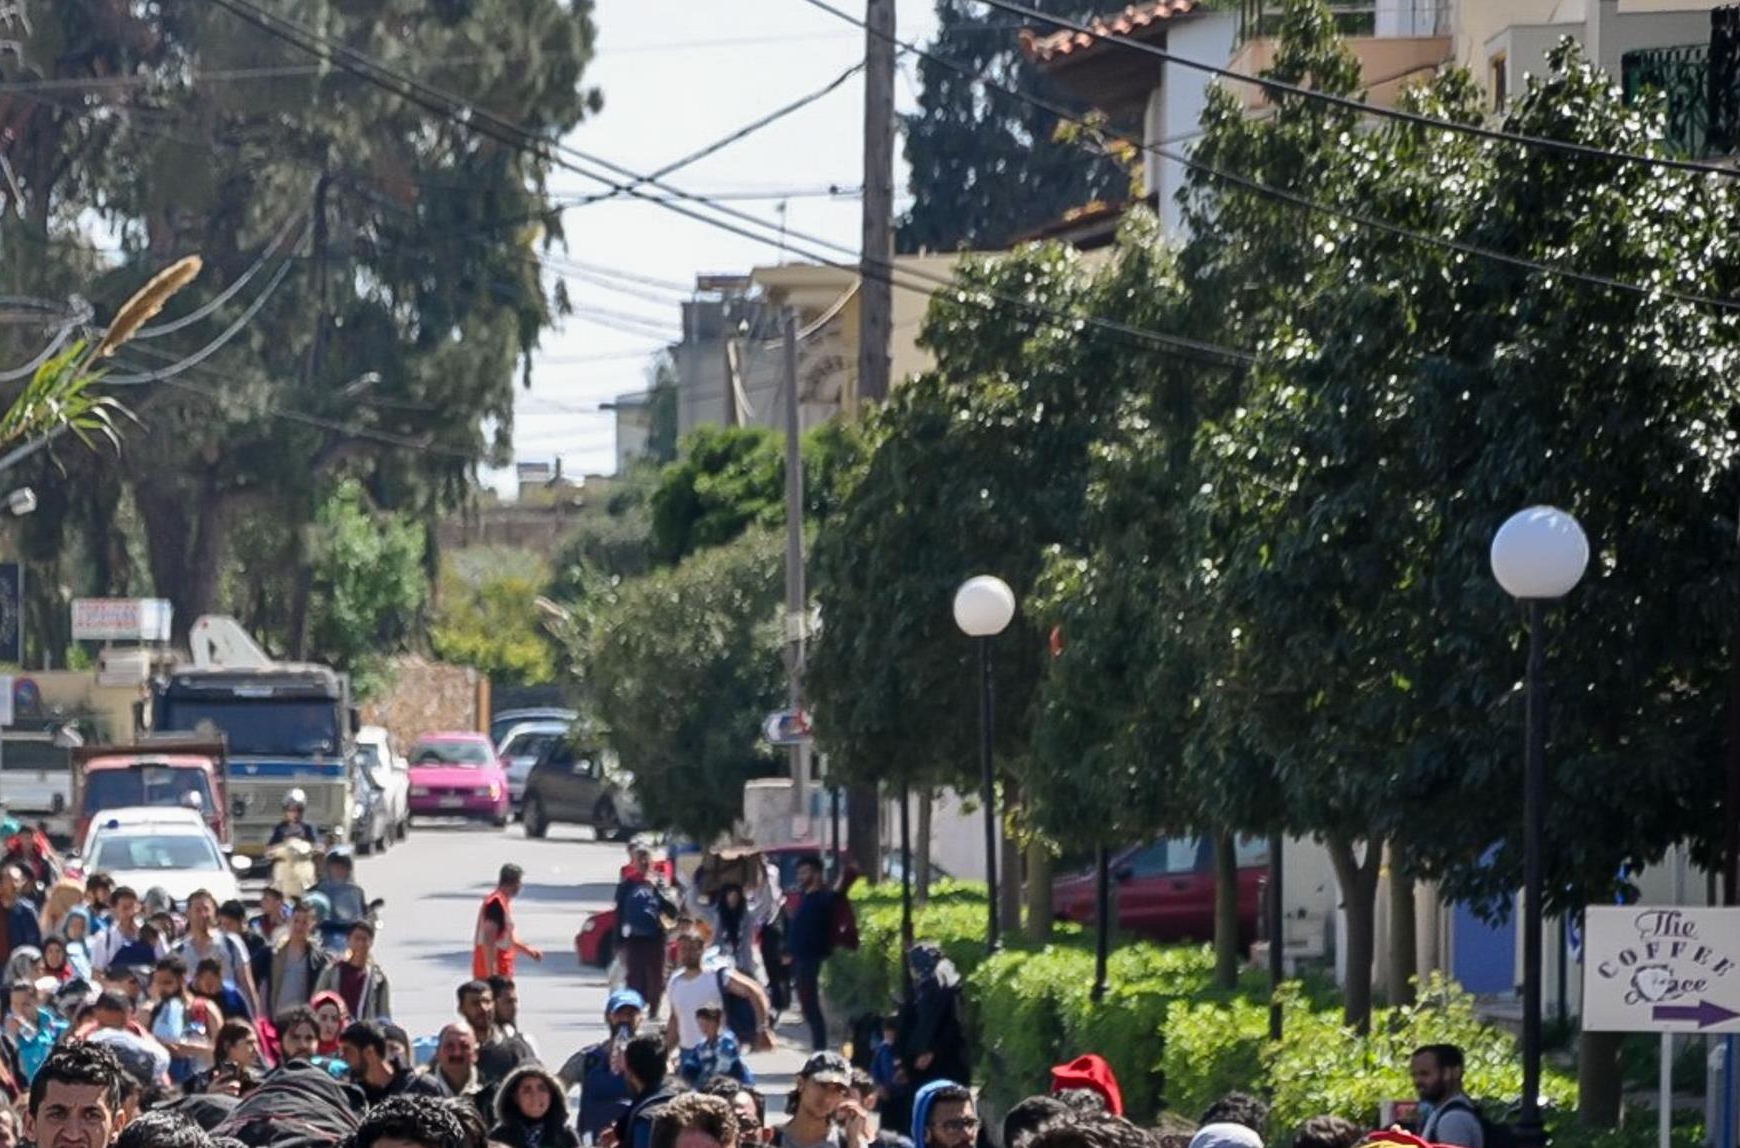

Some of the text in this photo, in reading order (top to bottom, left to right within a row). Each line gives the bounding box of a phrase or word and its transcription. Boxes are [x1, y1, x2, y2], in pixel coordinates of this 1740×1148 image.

[1635, 910, 1698, 940] The
[1598, 941, 1735, 978] COFFEE
[1625, 964, 1708, 1005] ace
